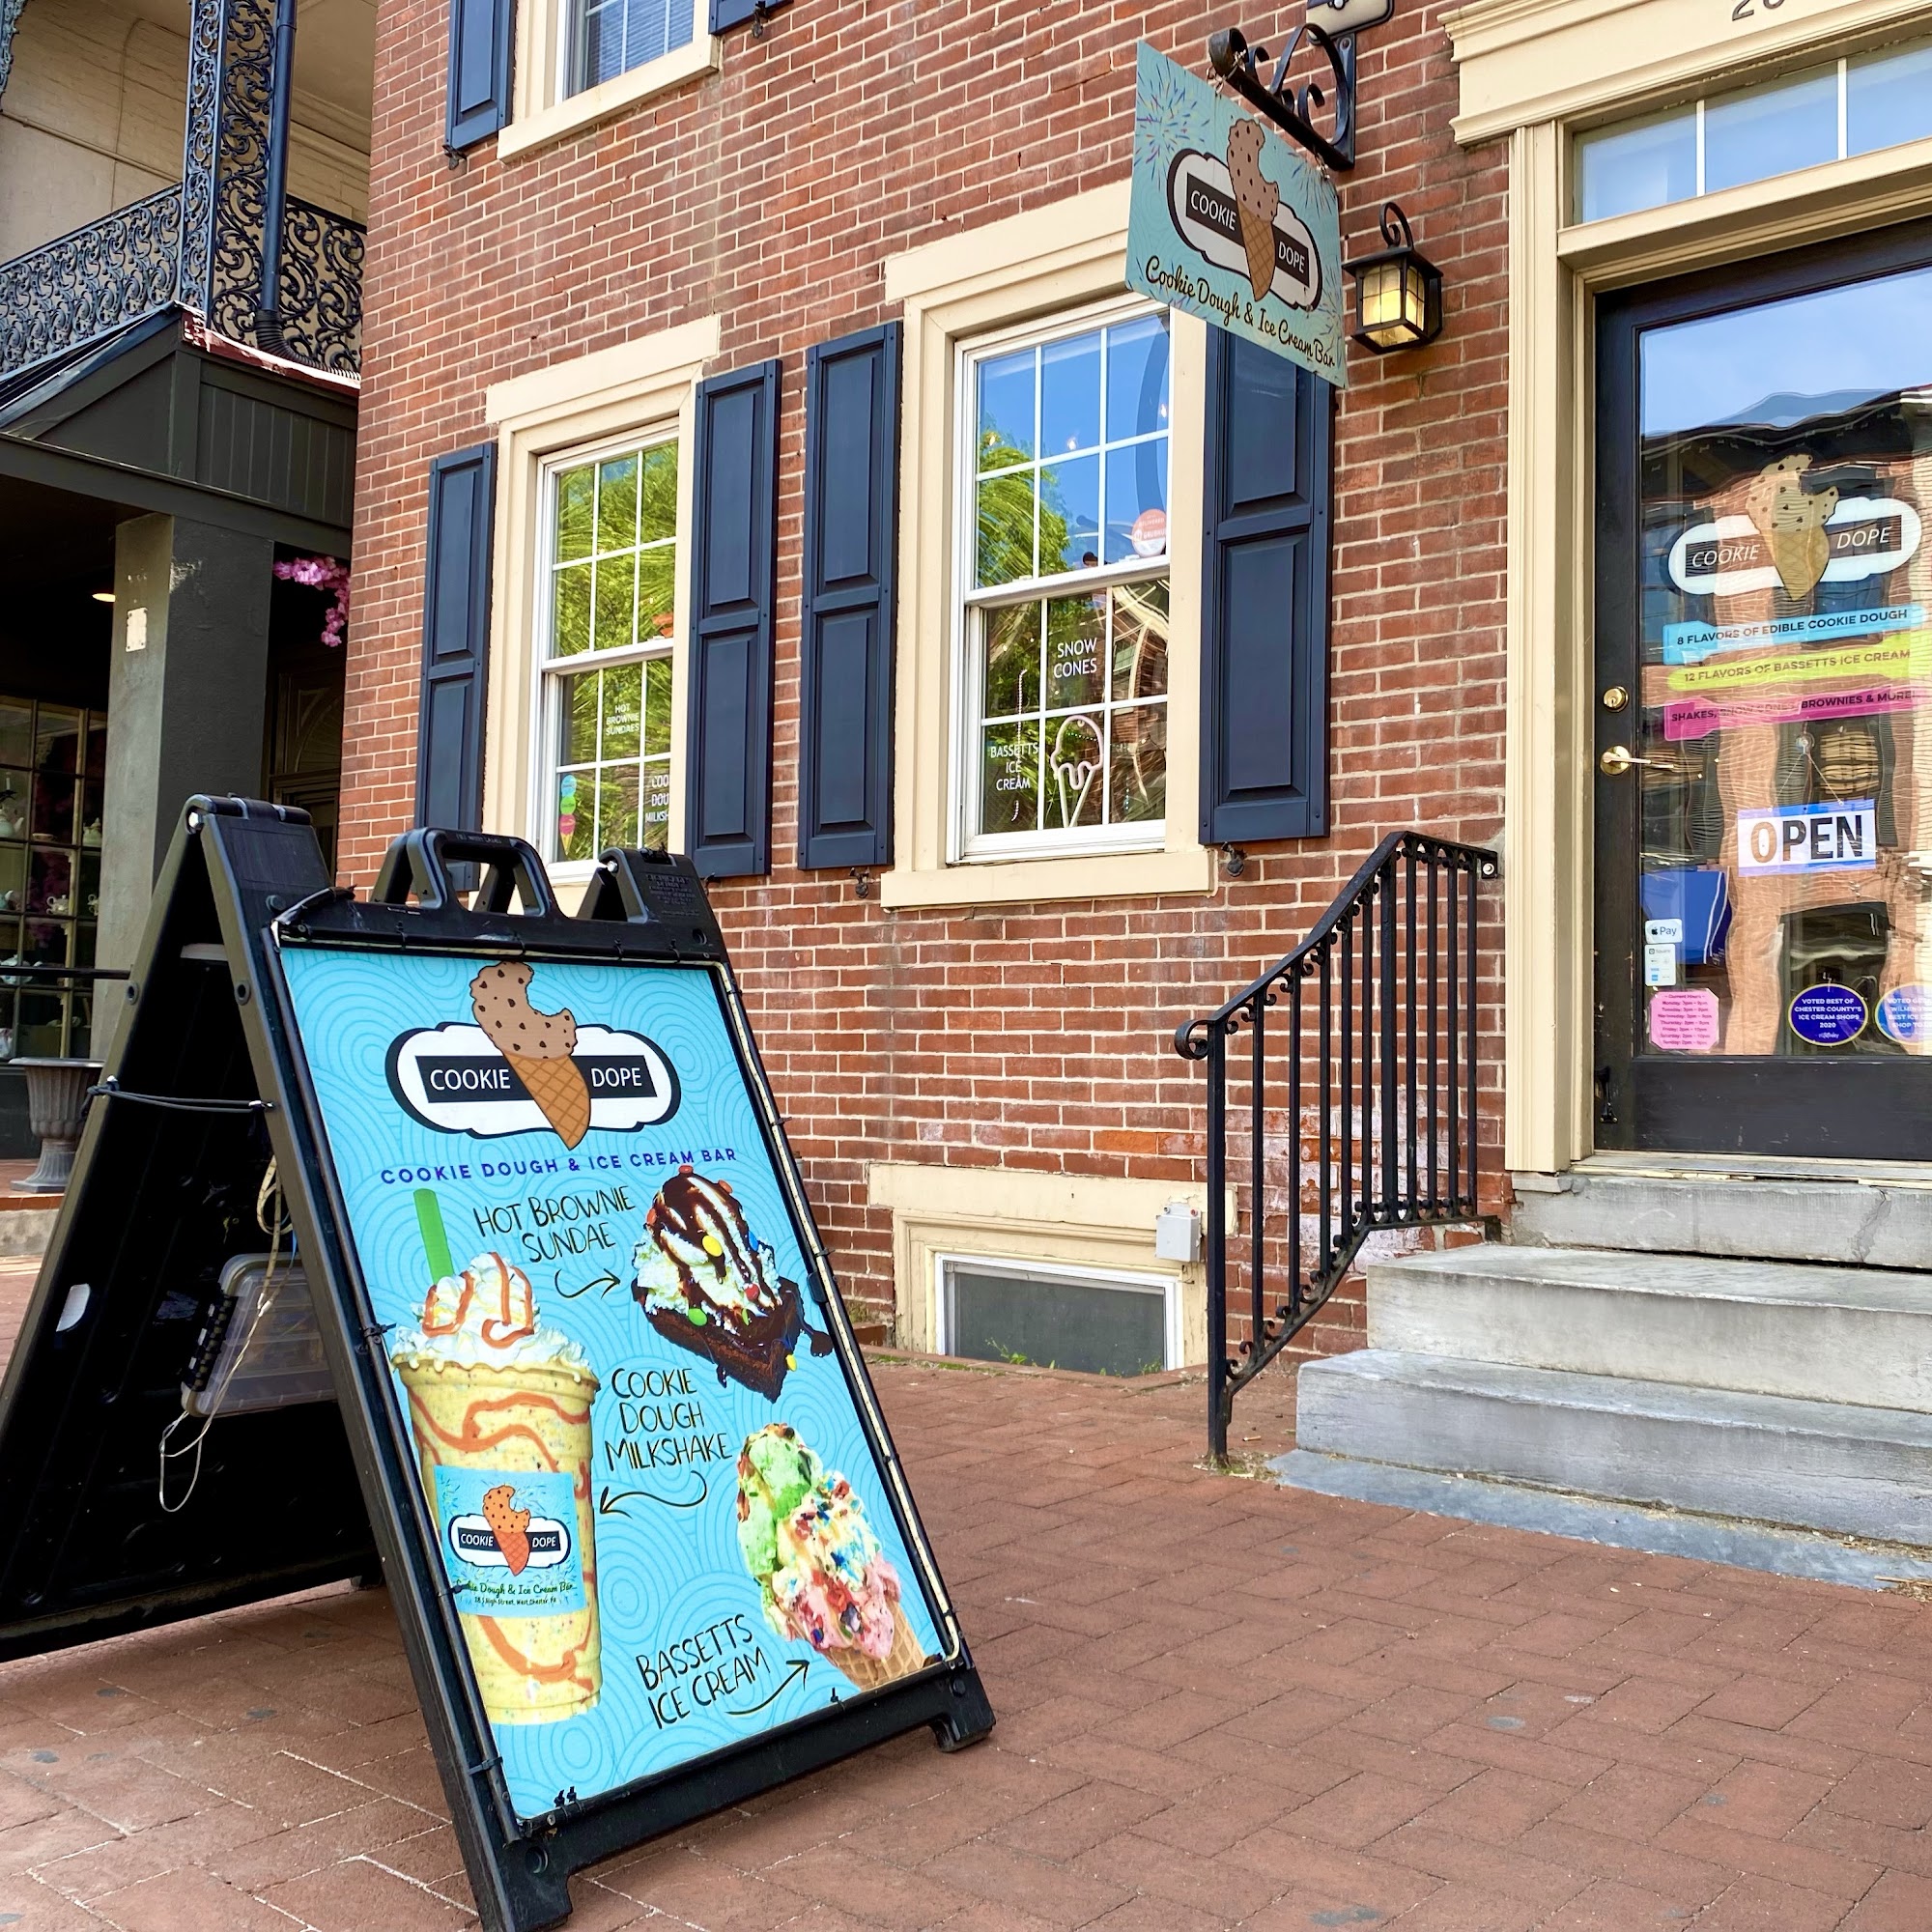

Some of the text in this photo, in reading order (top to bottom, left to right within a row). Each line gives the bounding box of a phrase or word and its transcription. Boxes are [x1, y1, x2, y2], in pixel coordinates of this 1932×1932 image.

[1190, 188, 1238, 232] COOKIE
[1277, 241, 1305, 275] DOPE
[1145, 255, 1335, 369] Cookie Dough & Ice Cream Bar
[1836, 526, 1892, 550] DOPE
[1691, 544, 1760, 568] COOKIE
[1677, 610, 1908, 644] 8 FLAVORS OF EDIBLE COOKIE DOUGH
[1057, 637, 1097, 659] SNOW
[1053, 657, 1097, 679] CONES
[1684, 649, 1911, 682] 12 FLAVORS OF BASSETTS ICE CREAM
[606, 713, 639, 725] BROWNIE
[614, 703, 631, 714] HOT
[1671, 709, 1718, 723] SHAKES,
[1801, 695, 1863, 709] BROWNIES
[1865, 694, 1875, 702] &
[605, 723, 640, 736] SUNDAES
[990, 741, 1039, 758] BASSETTS
[1006, 761, 1022, 774] ICE
[996, 777, 1031, 792] CREAM
[1749, 813, 1863, 865] OPEN
[1660, 926, 1677, 936] Pay
[430, 1067, 511, 1092] COOKIE
[590, 1067, 642, 1088] DOPE
[381, 1148, 737, 1185] COOKIE DOUGH & ICE CREAM BAR
[472, 1185, 637, 1237] HOT BROWNIE
[521, 1221, 617, 1264] SUNDAE
[611, 1367, 697, 1399] COOKIE
[618, 1401, 705, 1435] DOUGH
[604, 1433, 733, 1472] MILKSHAKE
[460, 1533, 495, 1547] COOKIE
[531, 1536, 556, 1548] DOPE
[480, 1582, 505, 1599] Dough
[507, 1584, 516, 1594] &
[518, 1584, 531, 1594] Ice
[533, 1583, 558, 1594] Cream
[559, 1580, 573, 1592] Bar
[636, 1613, 753, 1690] BASSETTS
[648, 1646, 771, 1729] ICE CREAM
